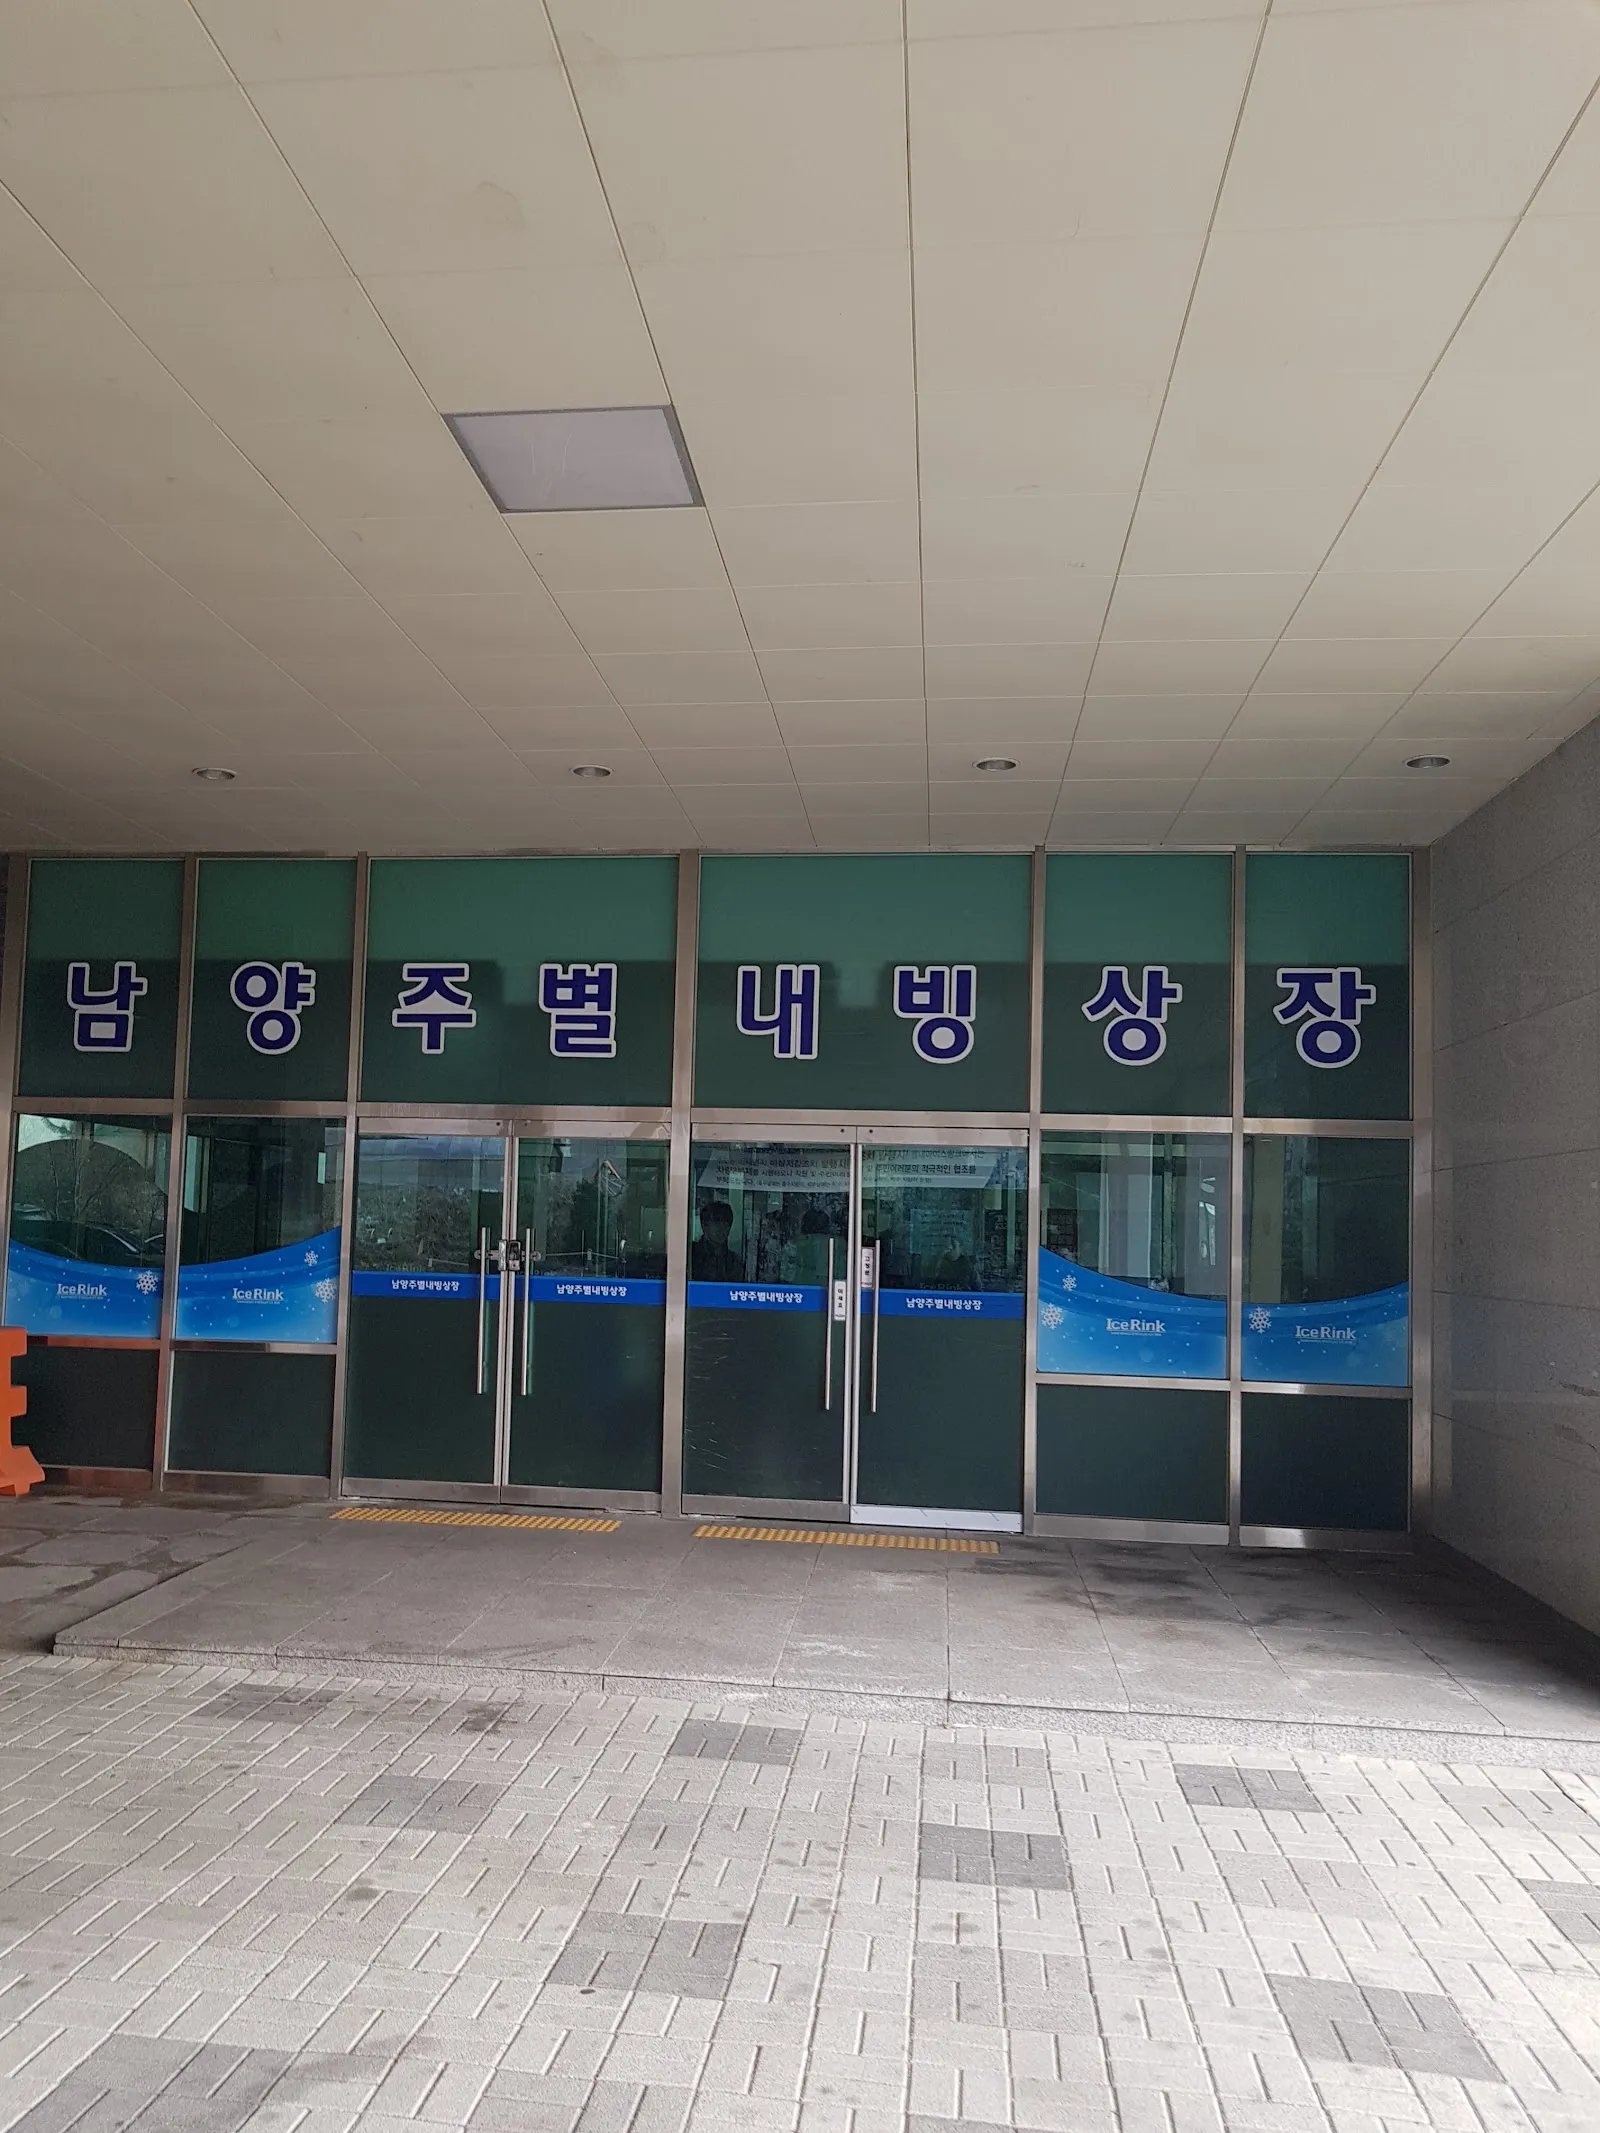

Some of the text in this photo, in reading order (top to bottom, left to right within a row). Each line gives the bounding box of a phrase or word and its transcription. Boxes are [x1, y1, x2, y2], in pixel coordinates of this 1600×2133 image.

[876, 1163, 919, 1174] 주민여러분의
[921, 1164, 951, 1174] 적극적인
[953, 1164, 977, 1174] 협조를
[391, 1278, 460, 1292] 남양주별내빙상장
[556, 1283, 628, 1297] 남양주별내빙상장
[729, 1290, 804, 1304] 남양주별내빙상장
[905, 1296, 983, 1311] 남양주별내빙상장
